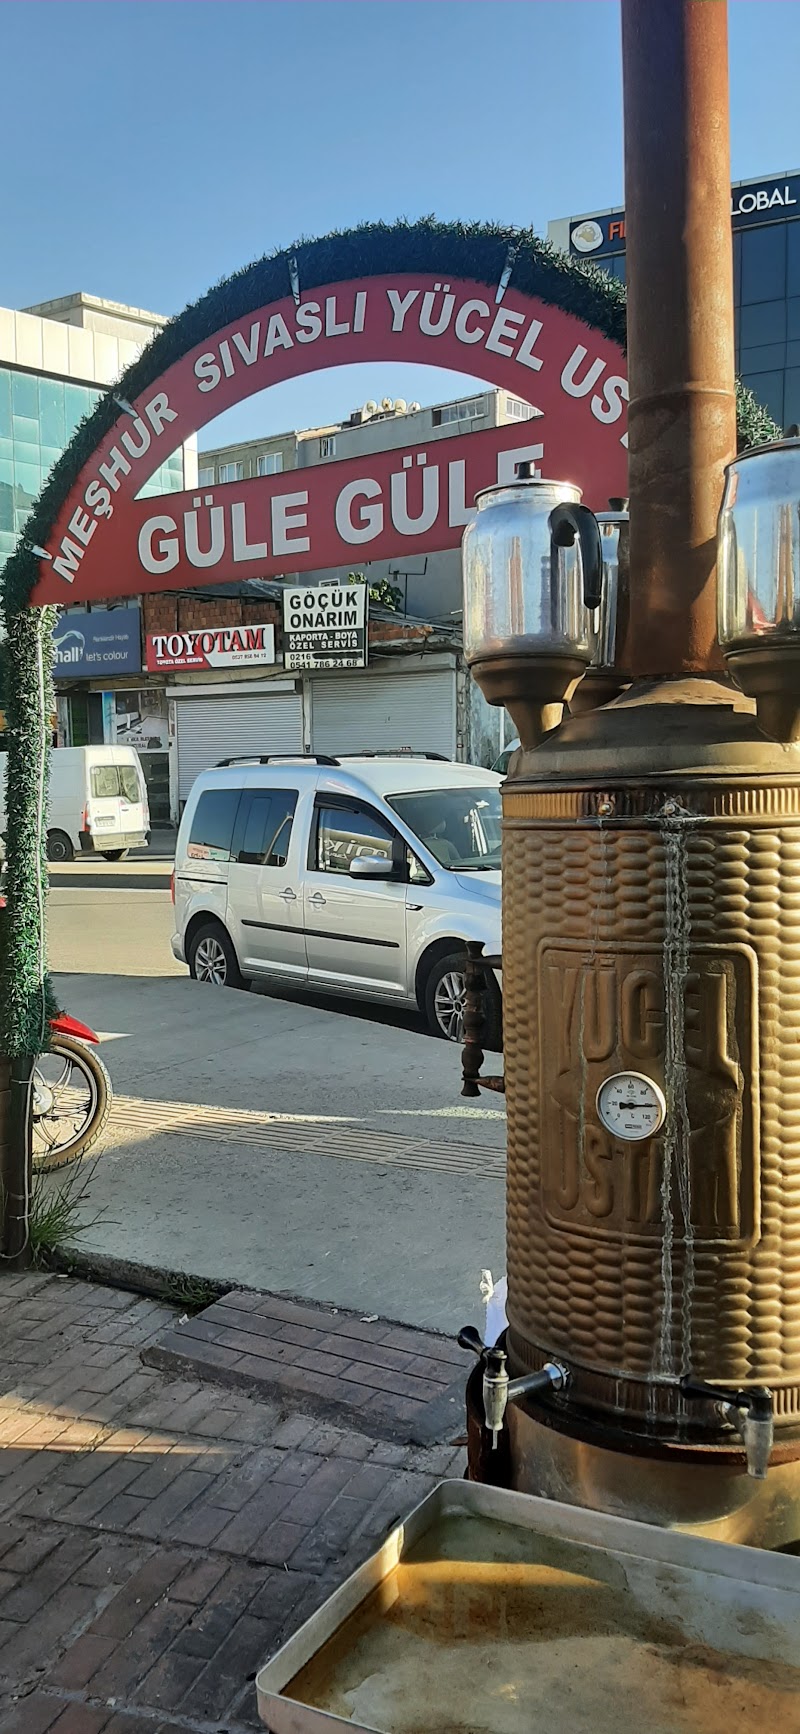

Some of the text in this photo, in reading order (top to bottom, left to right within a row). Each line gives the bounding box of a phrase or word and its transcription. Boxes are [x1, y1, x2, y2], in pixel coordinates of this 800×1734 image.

[608, 185, 798, 240] FI LOBAL
[51, 282, 631, 584] MEŞHUR SIVASLI YÜCEL US
[137, 490, 311, 575] GÜLE
[290, 589, 358, 612] GÖÇÜK
[290, 610, 358, 629] ONARIM
[152, 628, 266, 658] TOYOTAM
[289, 633, 328, 642] KAPORTA
[335, 631, 358, 640] BOYA
[289, 640, 357, 650] ÖZEL SERVİS
[54, 646, 79, 663] hall
[85, 650, 129, 662] let's colour
[289, 653, 311, 661] 0216
[290, 661, 311, 669] 0541
[314, 660, 331, 668] 786
[332, 660, 344, 668] 24
